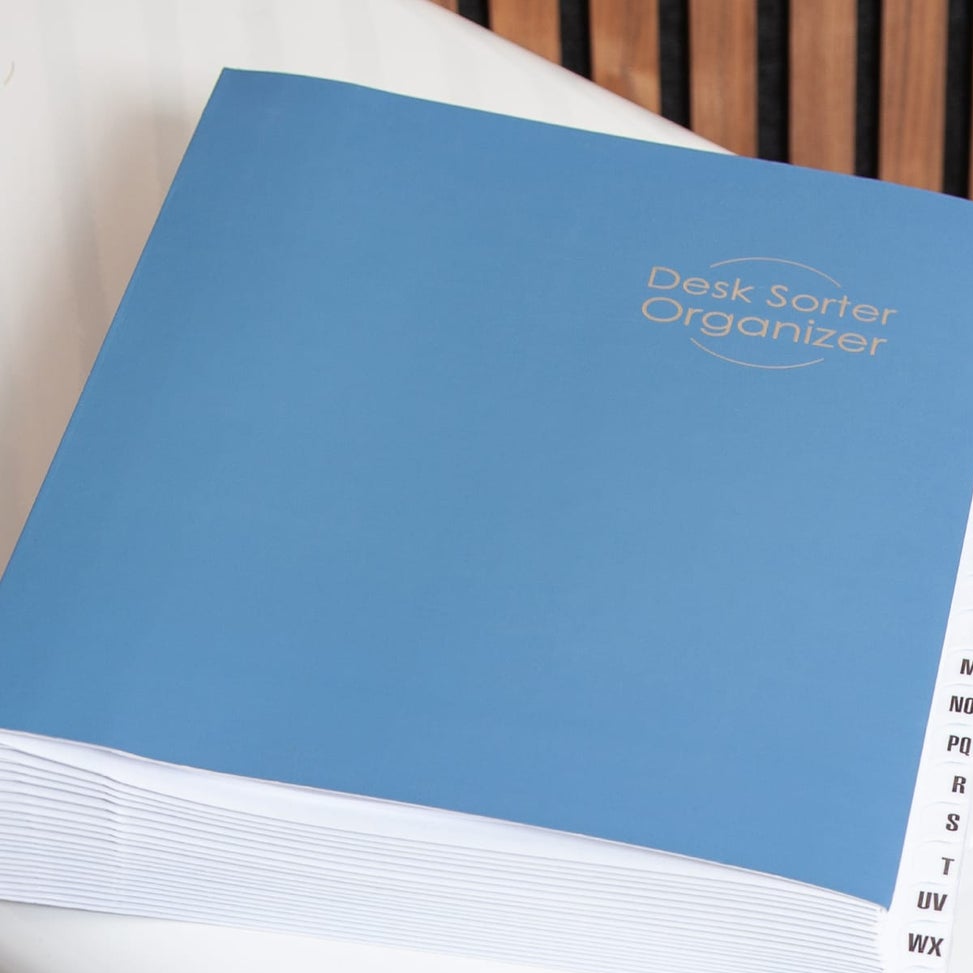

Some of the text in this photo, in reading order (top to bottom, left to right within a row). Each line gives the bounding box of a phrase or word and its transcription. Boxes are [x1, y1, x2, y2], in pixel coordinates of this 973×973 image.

[648, 265, 898, 326] Desk Sorter
[641, 296, 888, 357] Organizer
[946, 734, 972, 757] PQ
[951, 775, 967, 794] R
[945, 813, 960, 832] S
[941, 857, 955, 876] T
[917, 890, 948, 912] UV
[908, 933, 944, 957] WX
